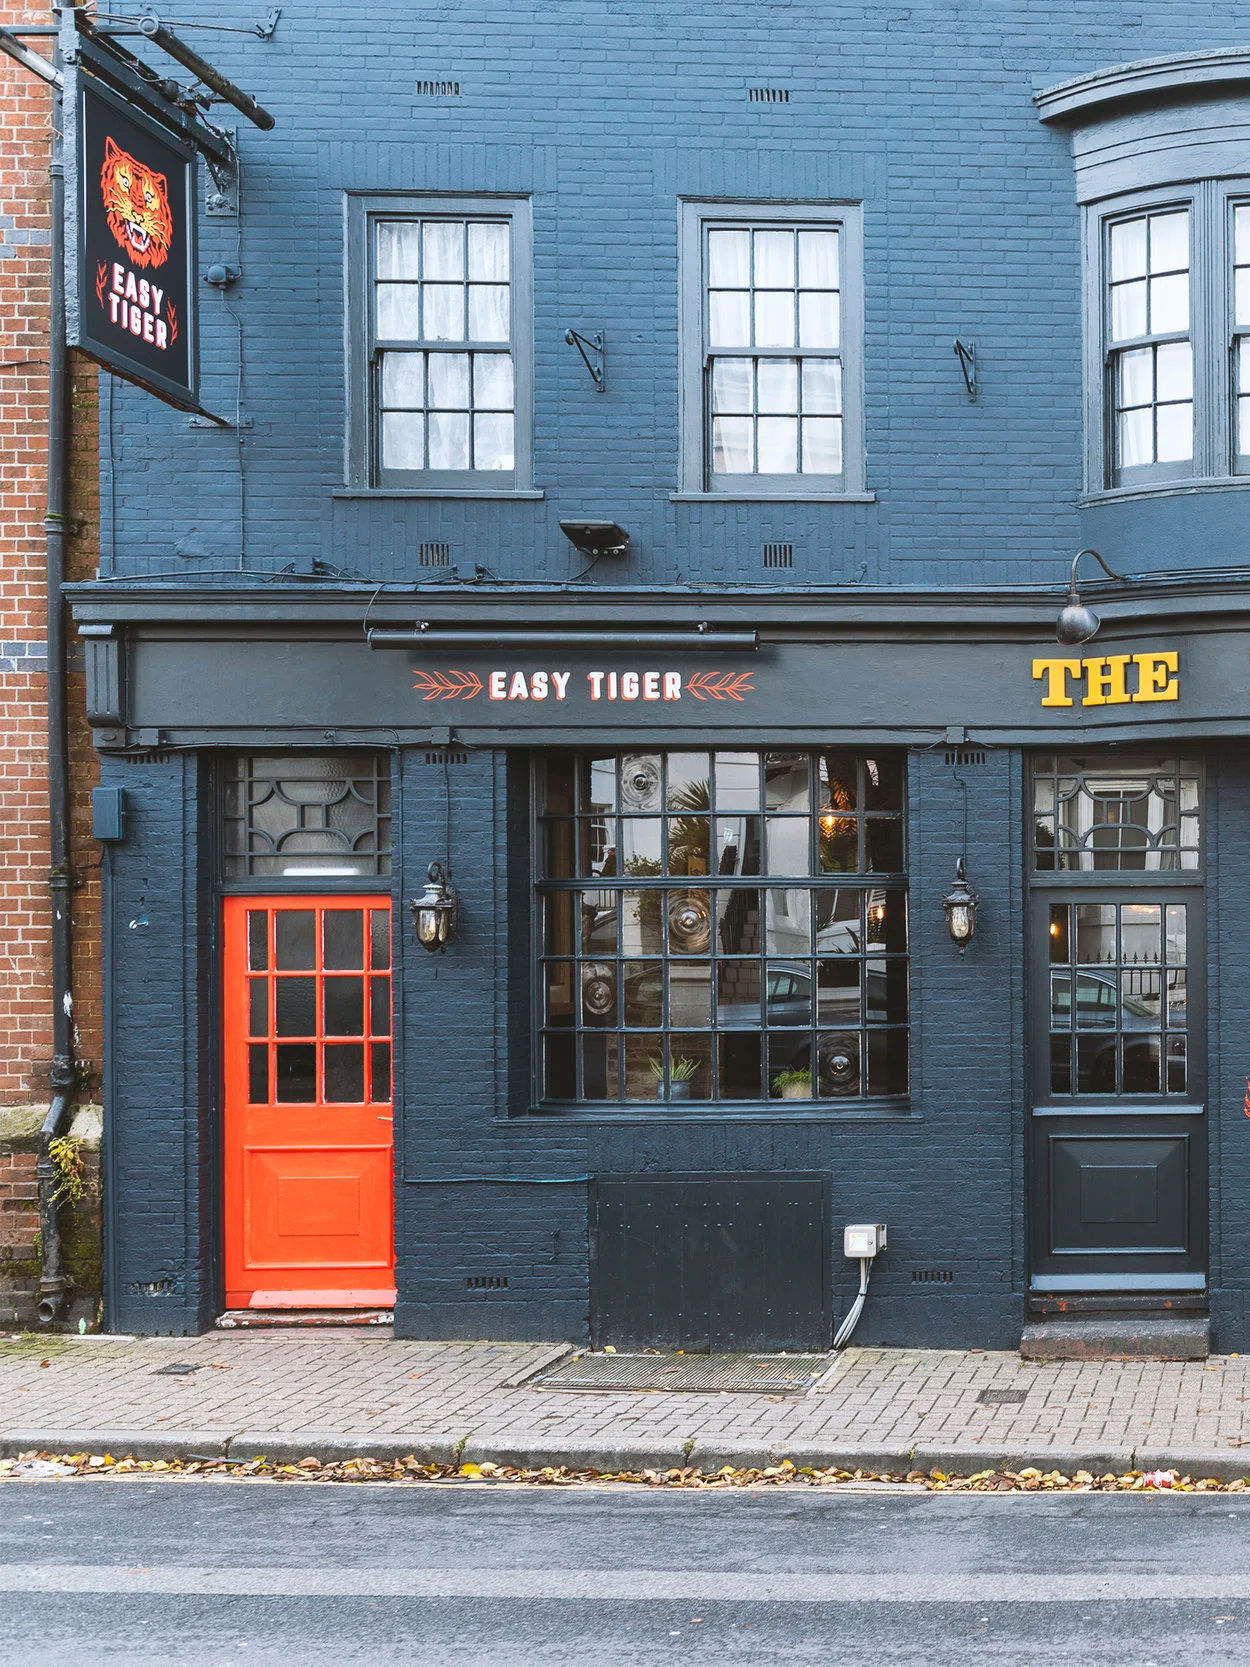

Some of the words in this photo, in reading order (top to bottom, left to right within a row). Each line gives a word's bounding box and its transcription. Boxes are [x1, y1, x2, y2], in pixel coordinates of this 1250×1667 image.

[111, 262, 163, 316] EASY
[108, 291, 167, 350] TIGER
[489, 671, 571, 701] EASY
[587, 671, 682, 701] TIGER
[1032, 651, 1180, 708] THE
